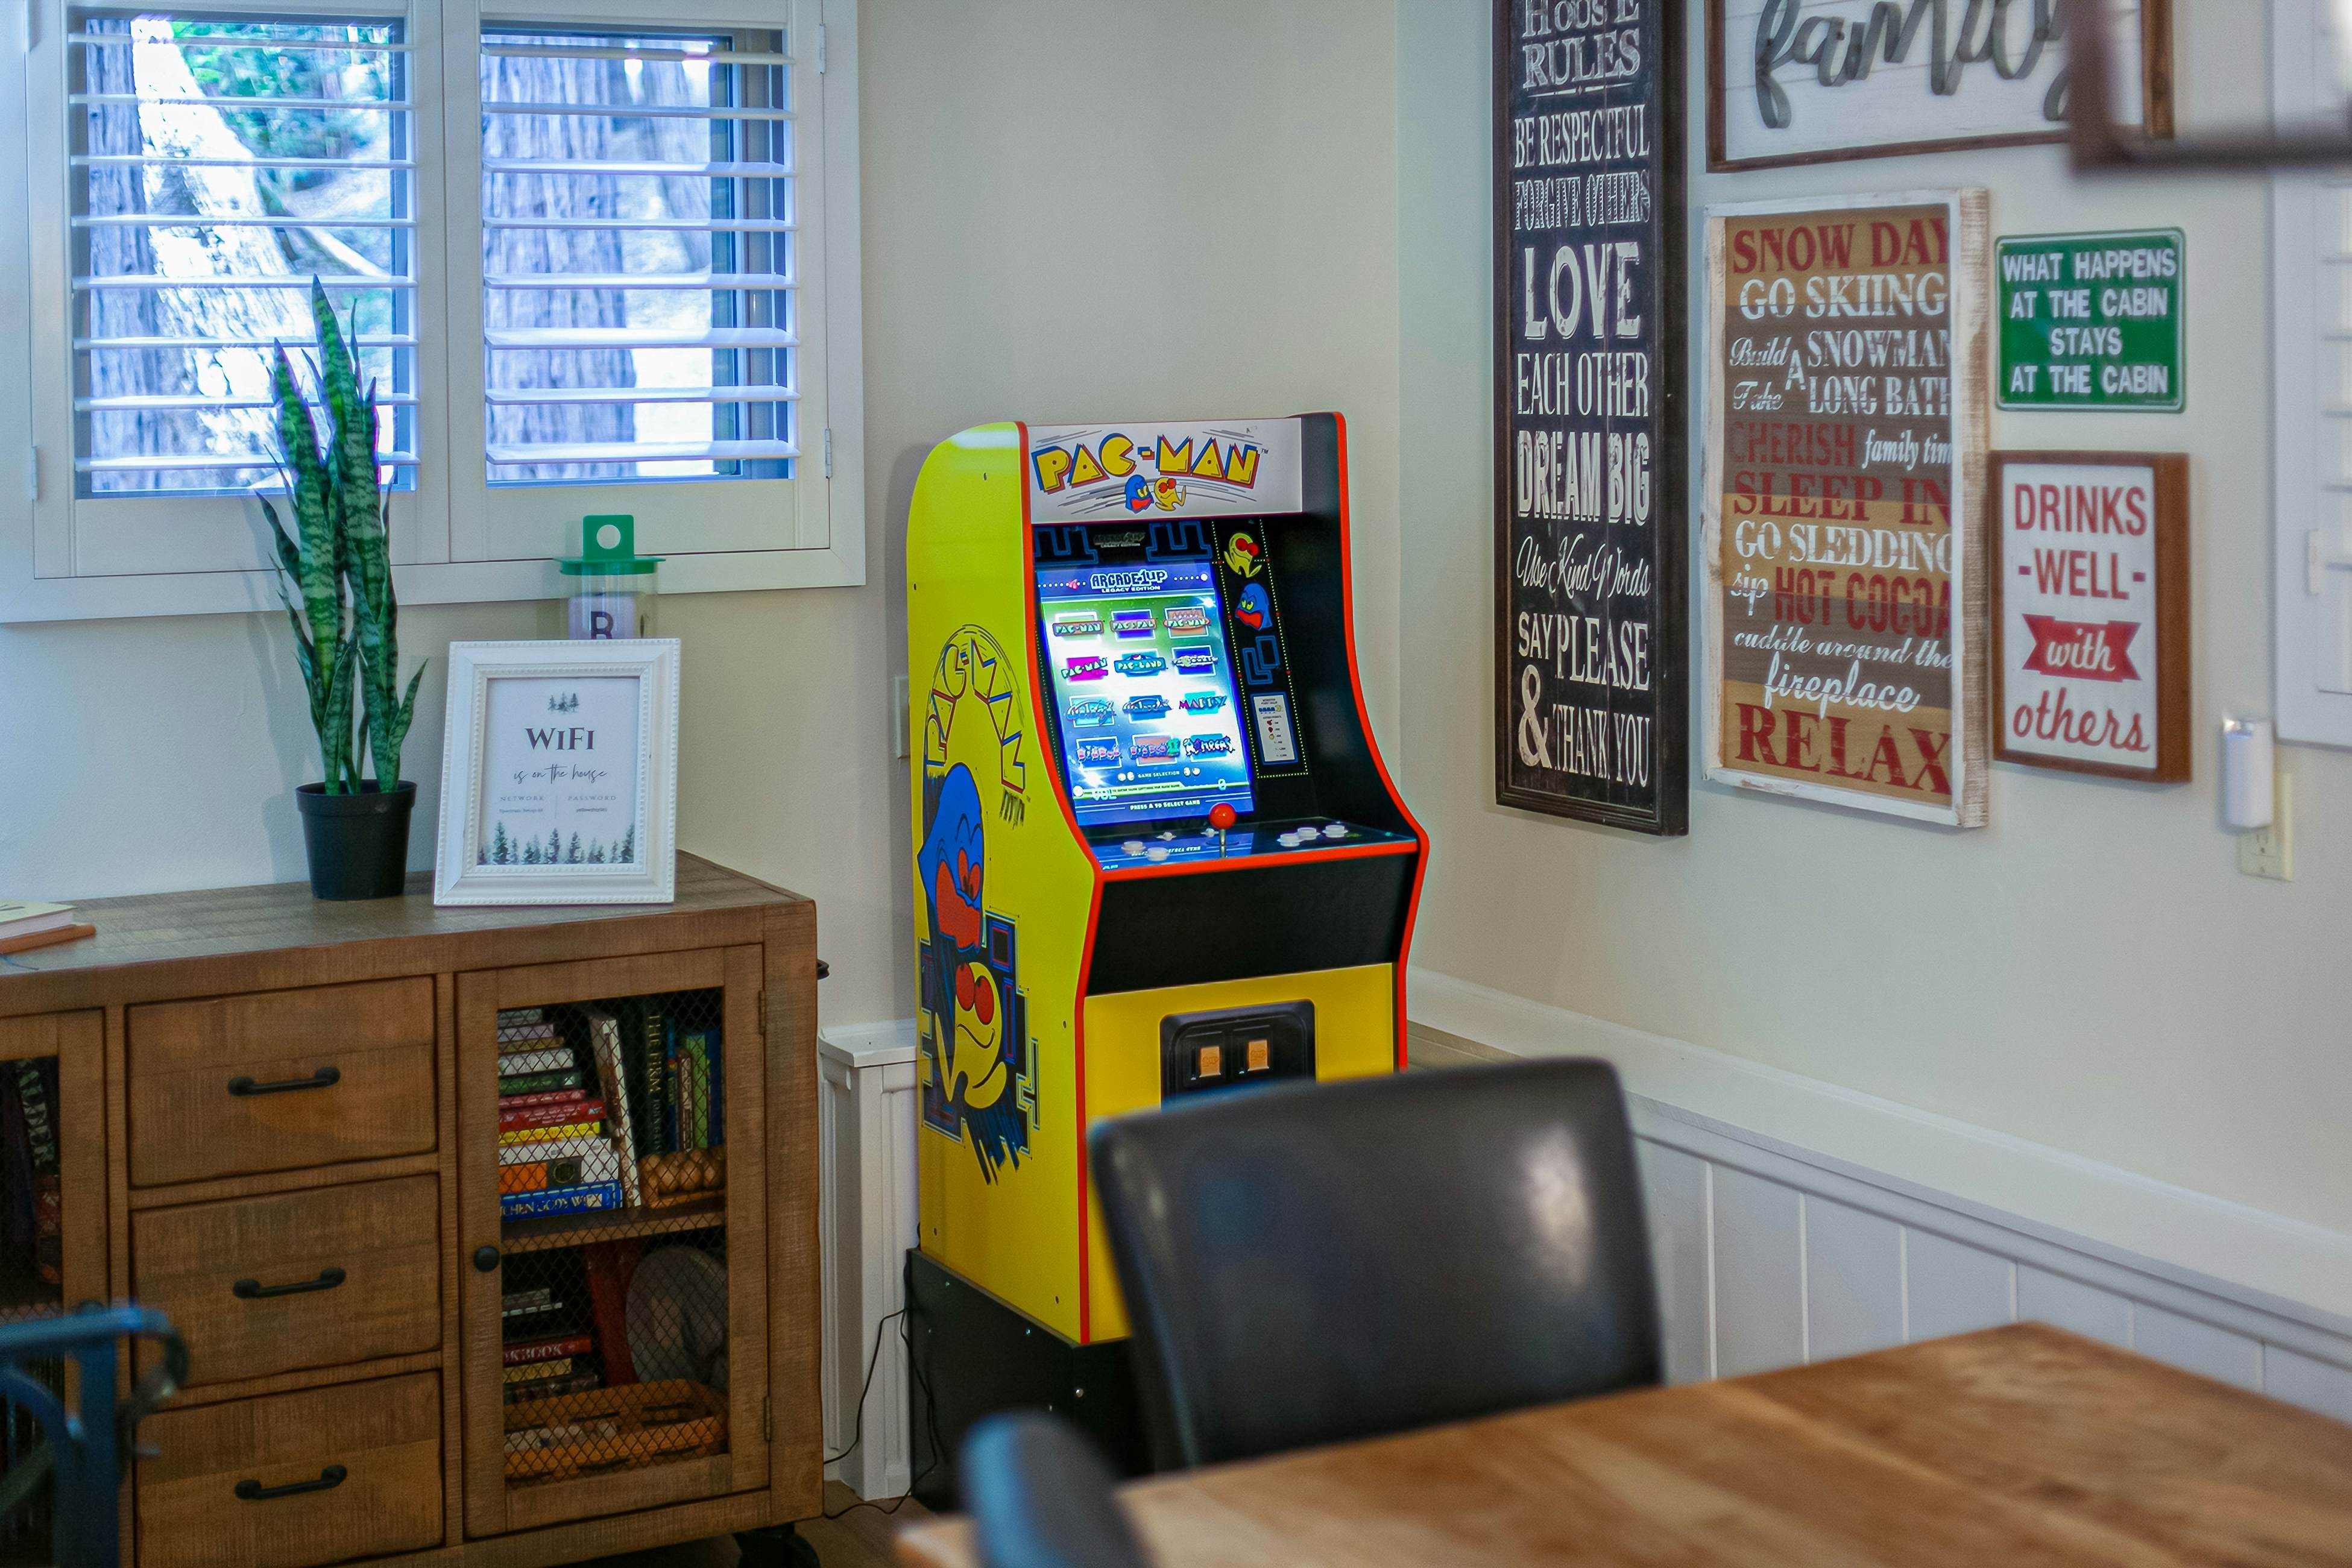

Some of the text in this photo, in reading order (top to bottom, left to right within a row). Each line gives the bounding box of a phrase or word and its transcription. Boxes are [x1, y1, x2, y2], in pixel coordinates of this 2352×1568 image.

[1522, 27, 1640, 89] RULES
[1515, 104, 1650, 168] BE RESPECTFUL
[1515, 169, 1650, 230] FORGIVE OTHERS
[1733, 224, 1855, 274] SNOW
[2003, 248, 2177, 282] WHAT HAPPENS
[1524, 242, 1640, 339] LOVE
[1739, 272, 1949, 320] GO SKIING
[2010, 288, 2169, 319] AT THE CABIN
[1729, 336, 1791, 367] Build
[1785, 349, 1806, 391] A
[2051, 326, 2123, 356] STAYS
[1517, 352, 1649, 417] EACH OTHER
[1809, 376, 1877, 415] LONG
[2010, 365, 2169, 394] AT THE CABIN
[1031, 432, 1260, 494] PAC-MAN
[1730, 421, 1856, 467] CHERISH
[1862, 429, 1919, 471] family
[1518, 430, 1650, 526] DREAM BIG
[1733, 470, 1884, 521] SLEEP
[2014, 483, 2148, 537] DRINKS
[1735, 520, 1782, 559] GO
[1516, 534, 1651, 600] Use Kind Words
[1730, 564, 1769, 616] sip
[1774, 567, 1836, 625] HOT
[1056, 623, 1102, 634] PAC-MAN
[1168, 619, 1205, 627] PAC-MAN
[1733, 625, 1816, 653] cuddle
[1816, 637, 1913, 664] around
[2046, 628, 2116, 672] with
[1061, 657, 1108, 679] PAC-MAN
[1518, 612, 1650, 691] SAY PLEASE
[1765, 651, 1920, 720] fireplace
[926, 637, 1025, 795] PAC-MAN
[1518, 664, 1650, 787] & THANK YOU
[2013, 687, 2149, 752] others
[513, 770, 528, 784] is
[544, 764, 568, 784] the
[572, 764, 608, 784] house
[1735, 702, 1953, 795] RELAX
